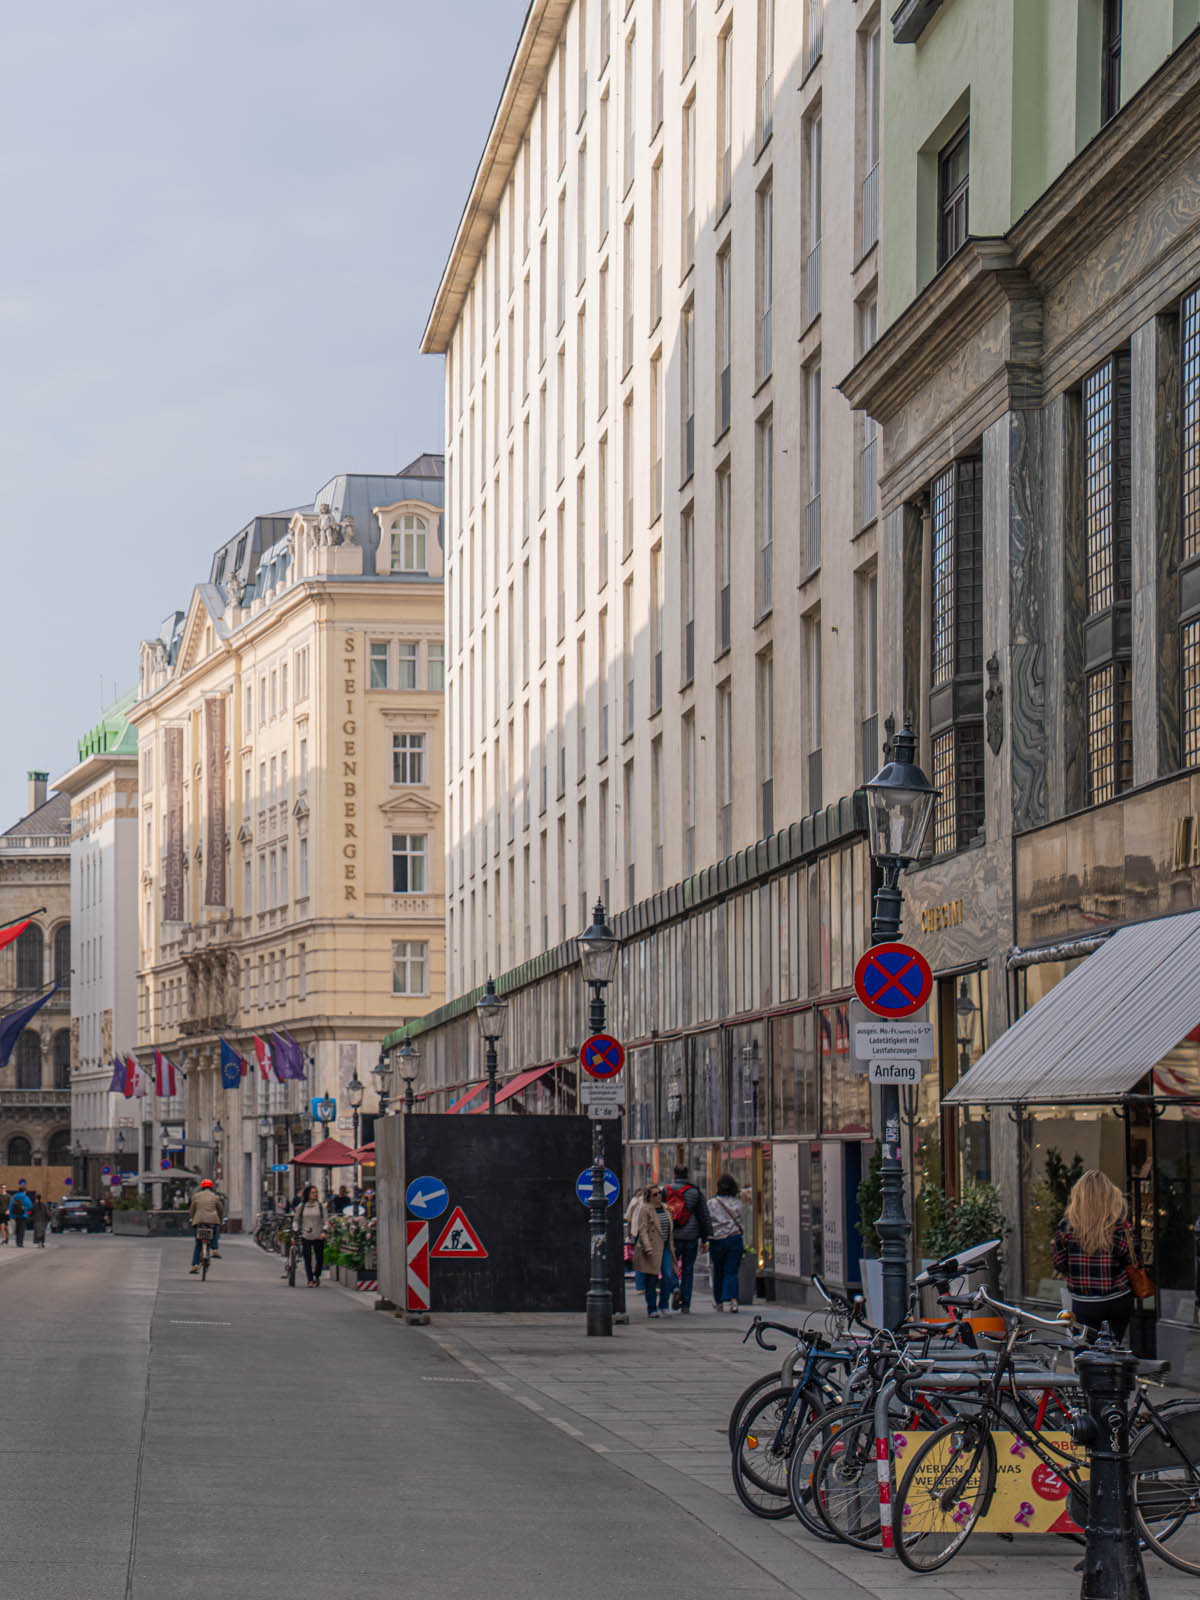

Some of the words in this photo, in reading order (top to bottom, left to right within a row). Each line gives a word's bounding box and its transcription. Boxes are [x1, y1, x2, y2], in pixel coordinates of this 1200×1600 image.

[343, 638, 358, 901] STEIGENBERGER
[869, 1037, 907, 1045] Ladetätigkeit
[872, 1047, 917, 1055] Lastfahrzeugen
[875, 1064, 915, 1080] Anfang
[594, 1107, 612, 1116] Ede
